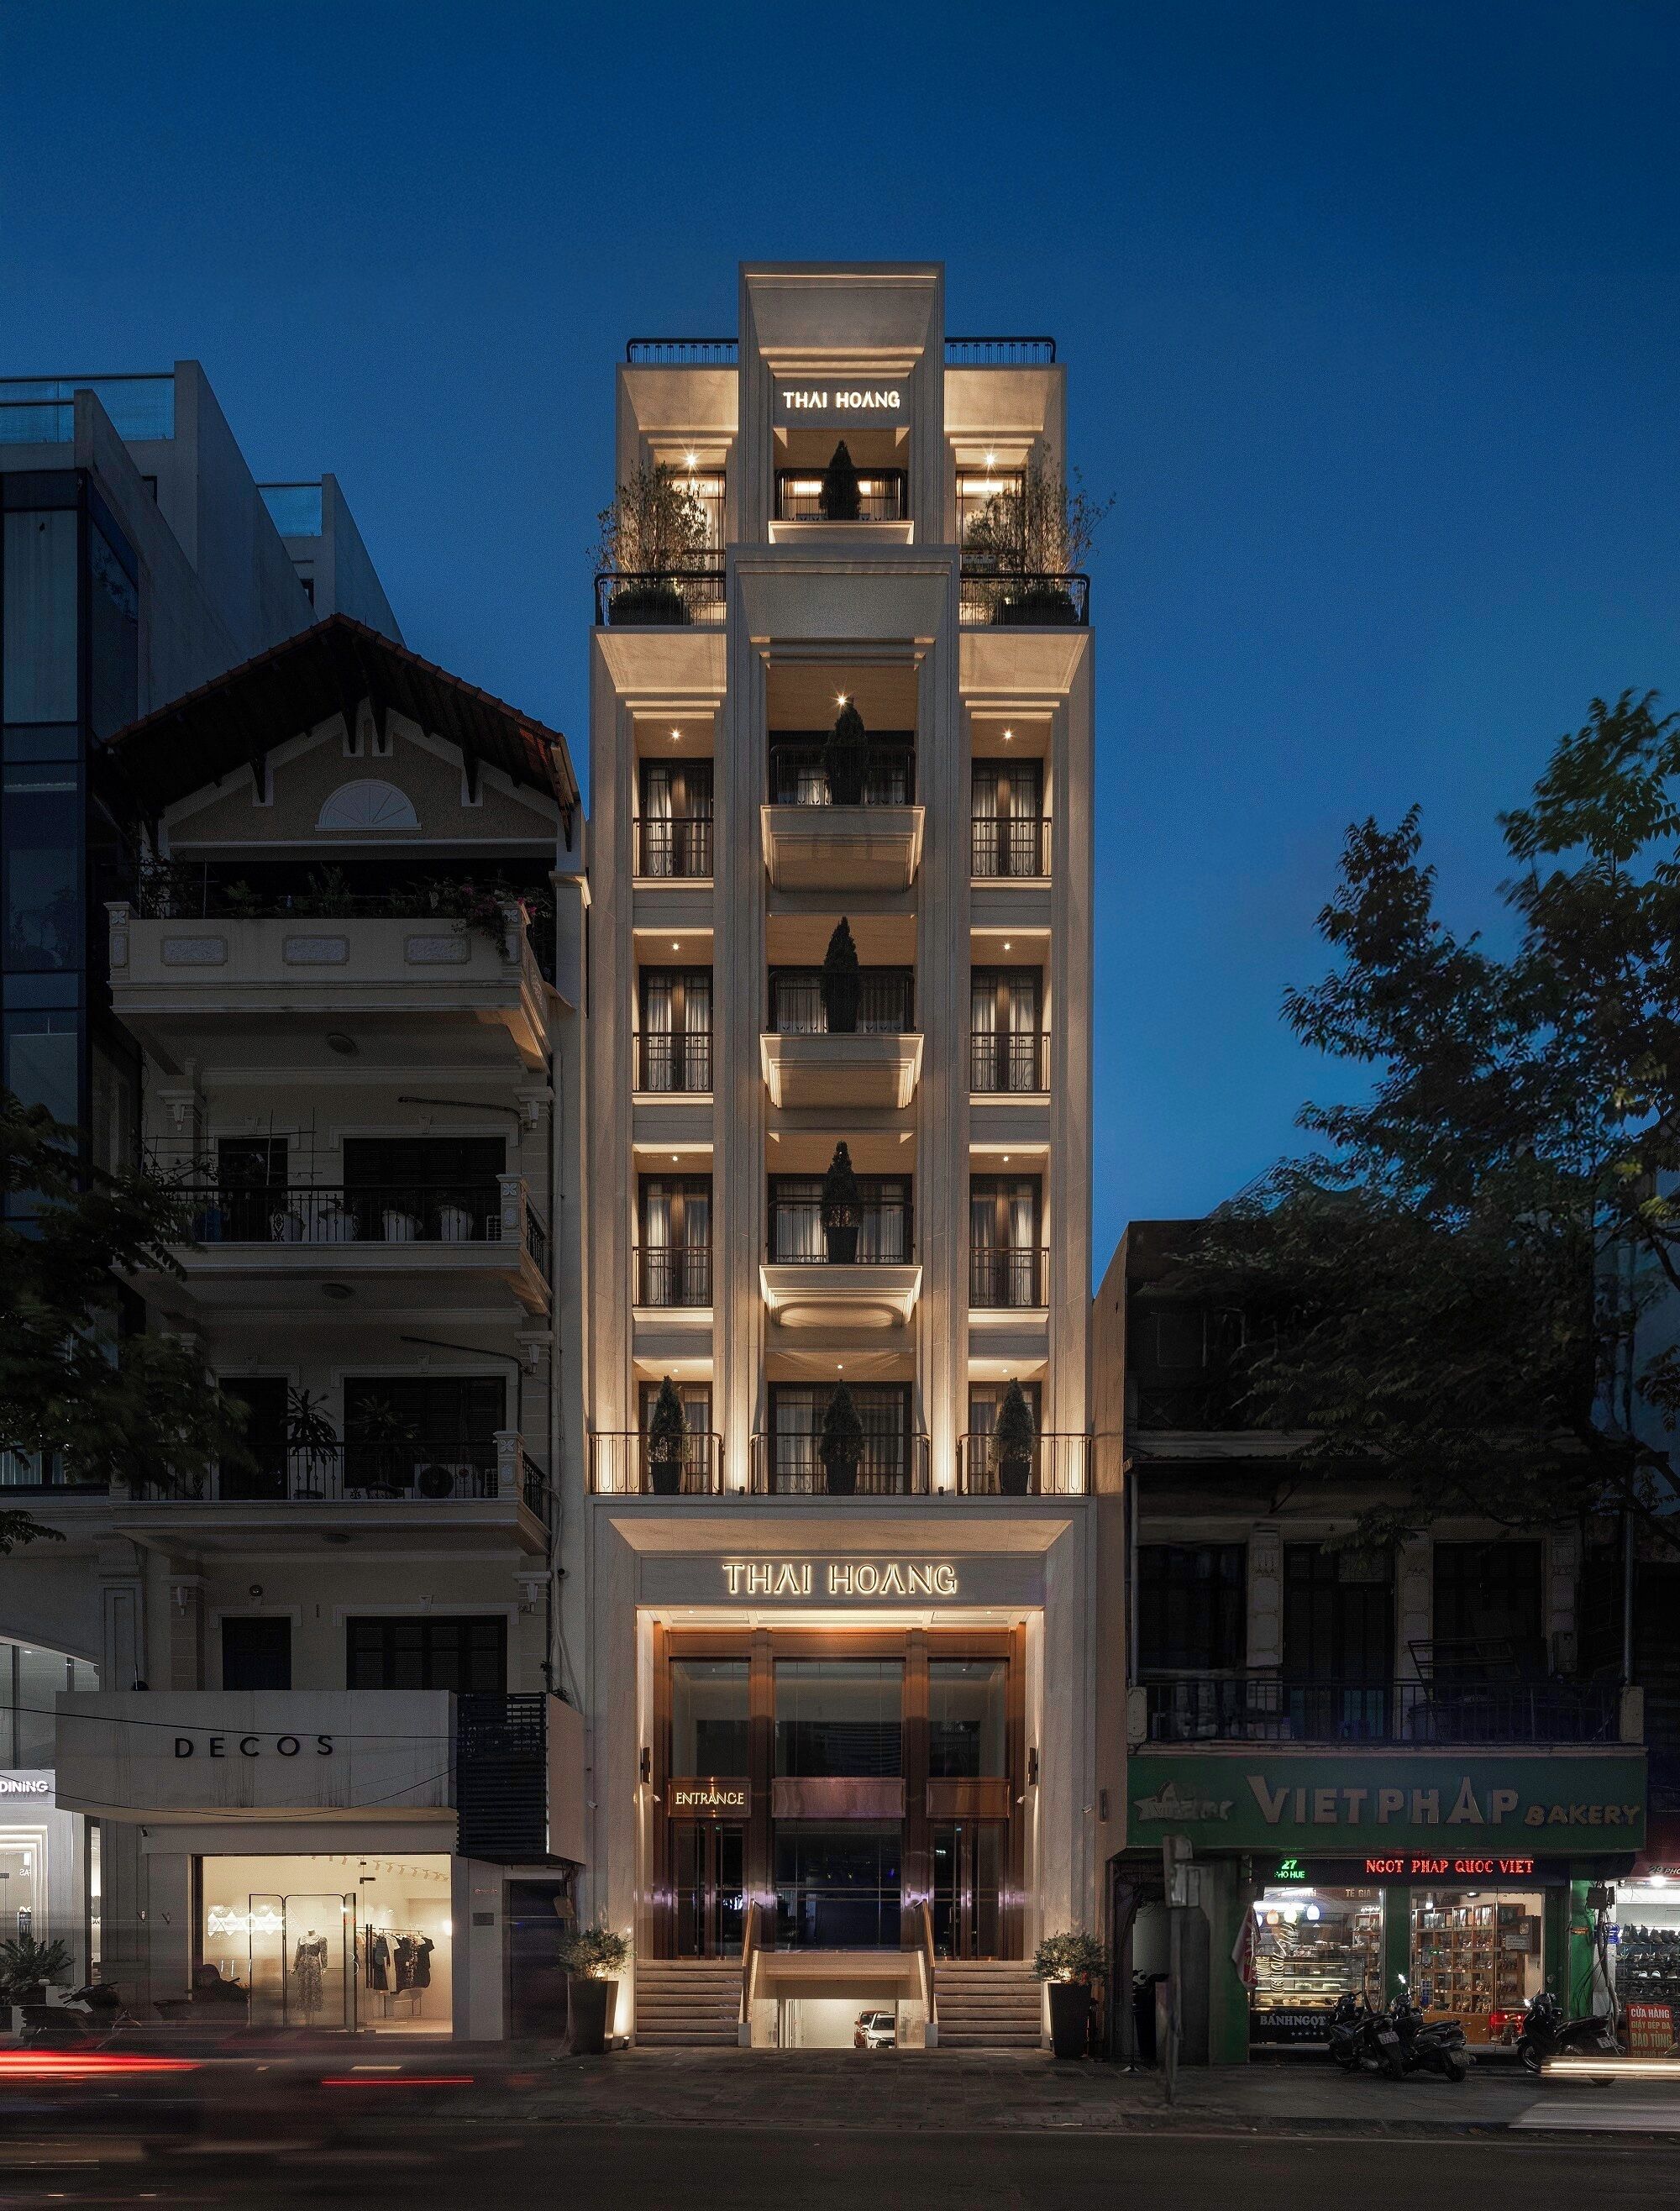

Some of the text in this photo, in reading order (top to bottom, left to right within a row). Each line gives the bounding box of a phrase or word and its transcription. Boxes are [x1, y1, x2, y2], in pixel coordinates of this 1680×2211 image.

[782, 391, 900, 408] THAI HOANG
[722, 1563, 958, 1594] THAI HOANG
[175, 1735, 333, 1758] DECOS
[0, 1780, 49, 1792] DINING
[675, 1792, 744, 1805] ENTRANCE
[1524, 1804, 1640, 1825] BAKERY
[1281, 1859, 1298, 1870] 27
[1366, 1860, 1534, 1873] NGOT PHAP QUOC VIET
[1648, 1866, 1663, 1874] 29
[1630, 2005, 1670, 2019] CỬA HÀNG
